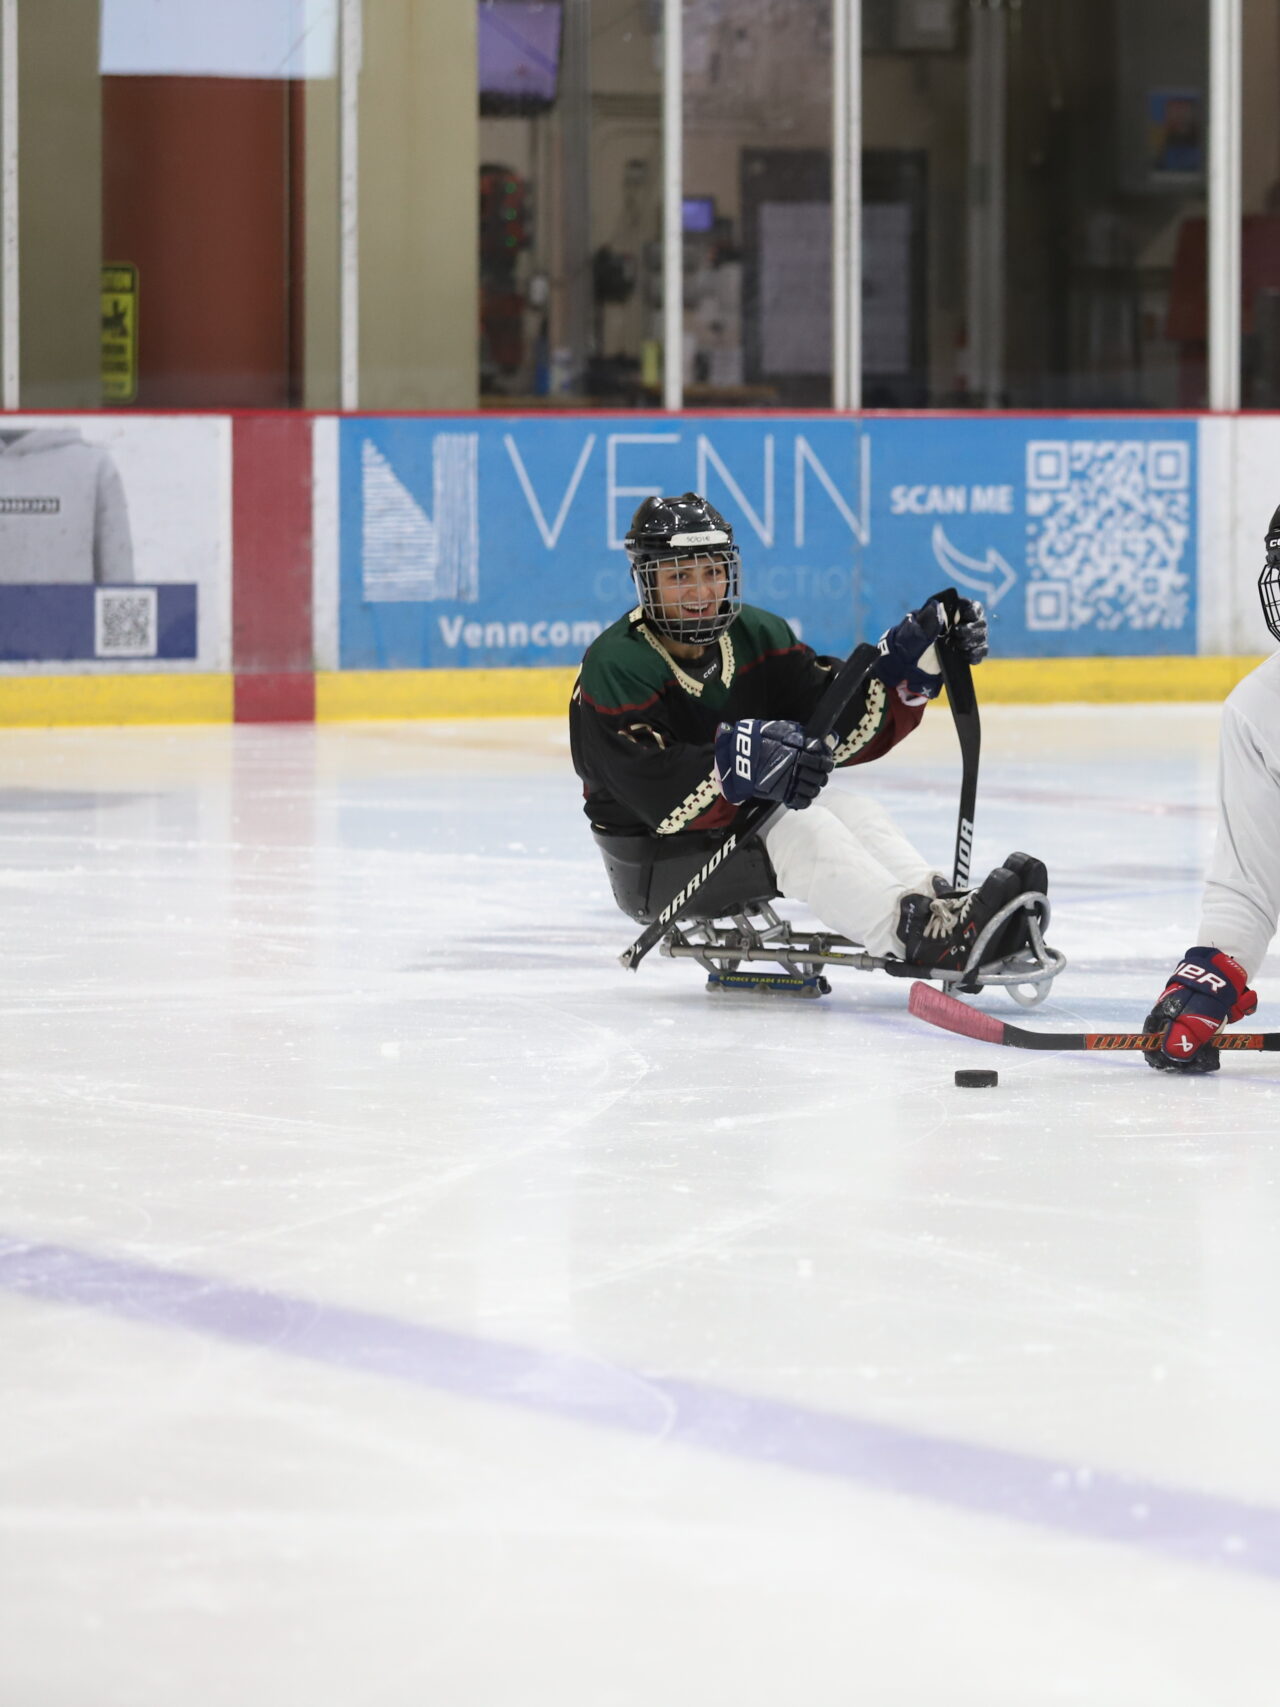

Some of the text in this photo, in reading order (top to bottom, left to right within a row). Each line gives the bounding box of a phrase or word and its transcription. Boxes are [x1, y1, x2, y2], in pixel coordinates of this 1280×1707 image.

[503, 433, 871, 549] VENN
[890, 485, 1014, 514] SCAN ME
[703, 663, 717, 680] CCM
[659, 833, 737, 925] ARRIOR
